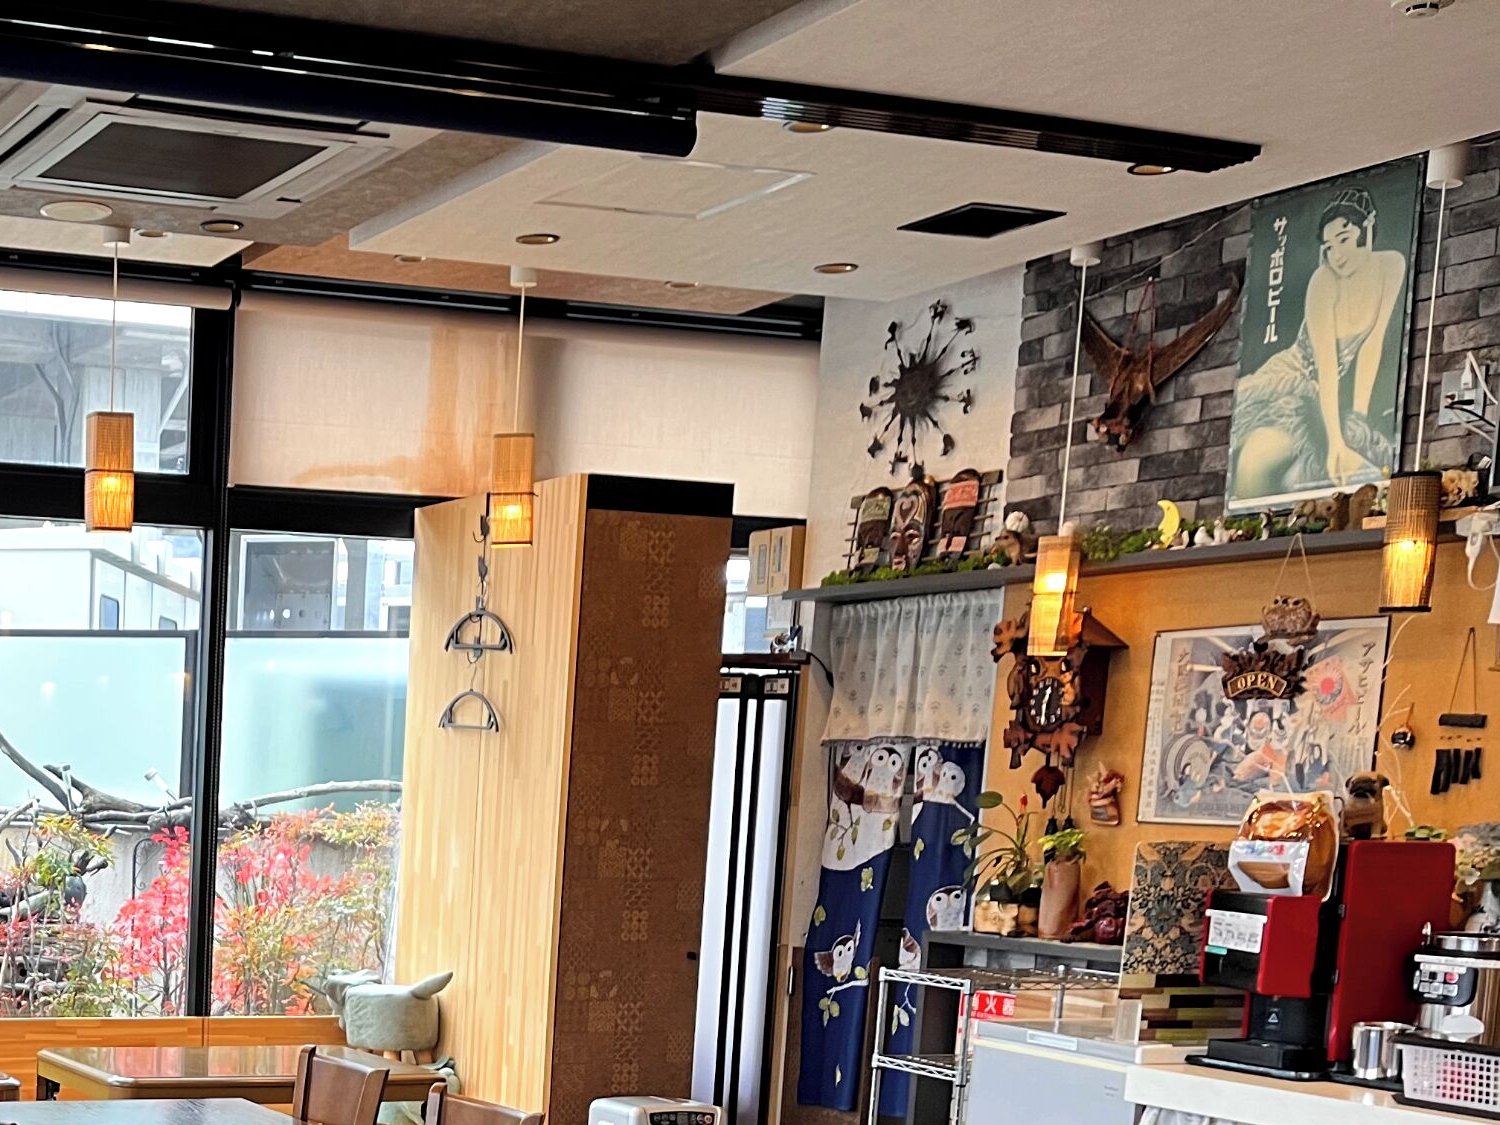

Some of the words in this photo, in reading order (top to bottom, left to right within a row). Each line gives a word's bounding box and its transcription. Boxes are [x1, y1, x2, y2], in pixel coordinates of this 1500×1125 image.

[1263, 216, 1288, 345] サッポロビール
[1237, 673, 1278, 690] OPEN
